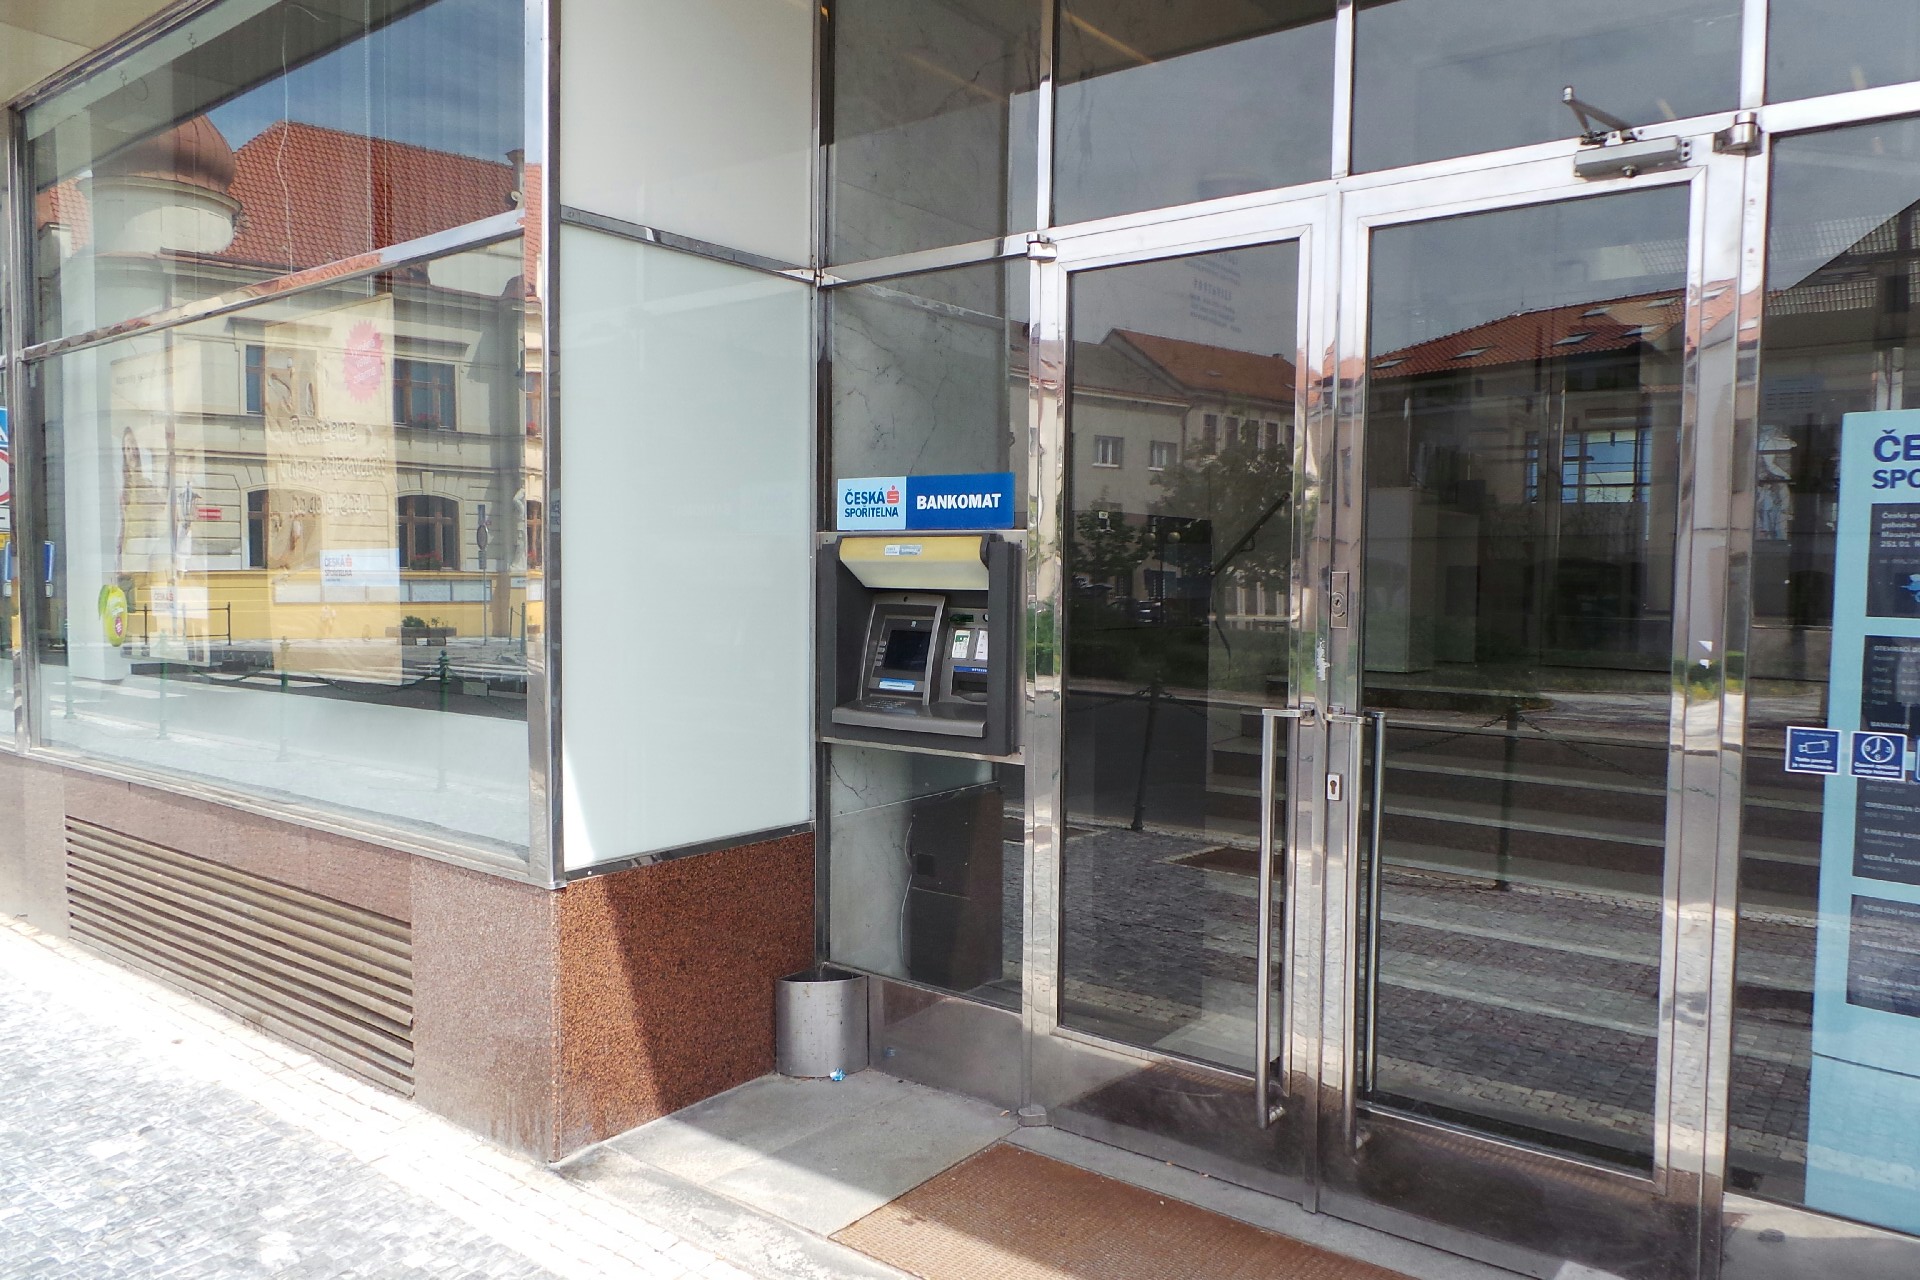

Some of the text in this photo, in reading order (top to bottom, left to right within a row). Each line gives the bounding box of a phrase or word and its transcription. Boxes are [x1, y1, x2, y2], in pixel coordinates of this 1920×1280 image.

[845, 488, 1001, 510] ČESKÁ BANKOMAT
[845, 505, 899, 518] SPOŘITELNA
